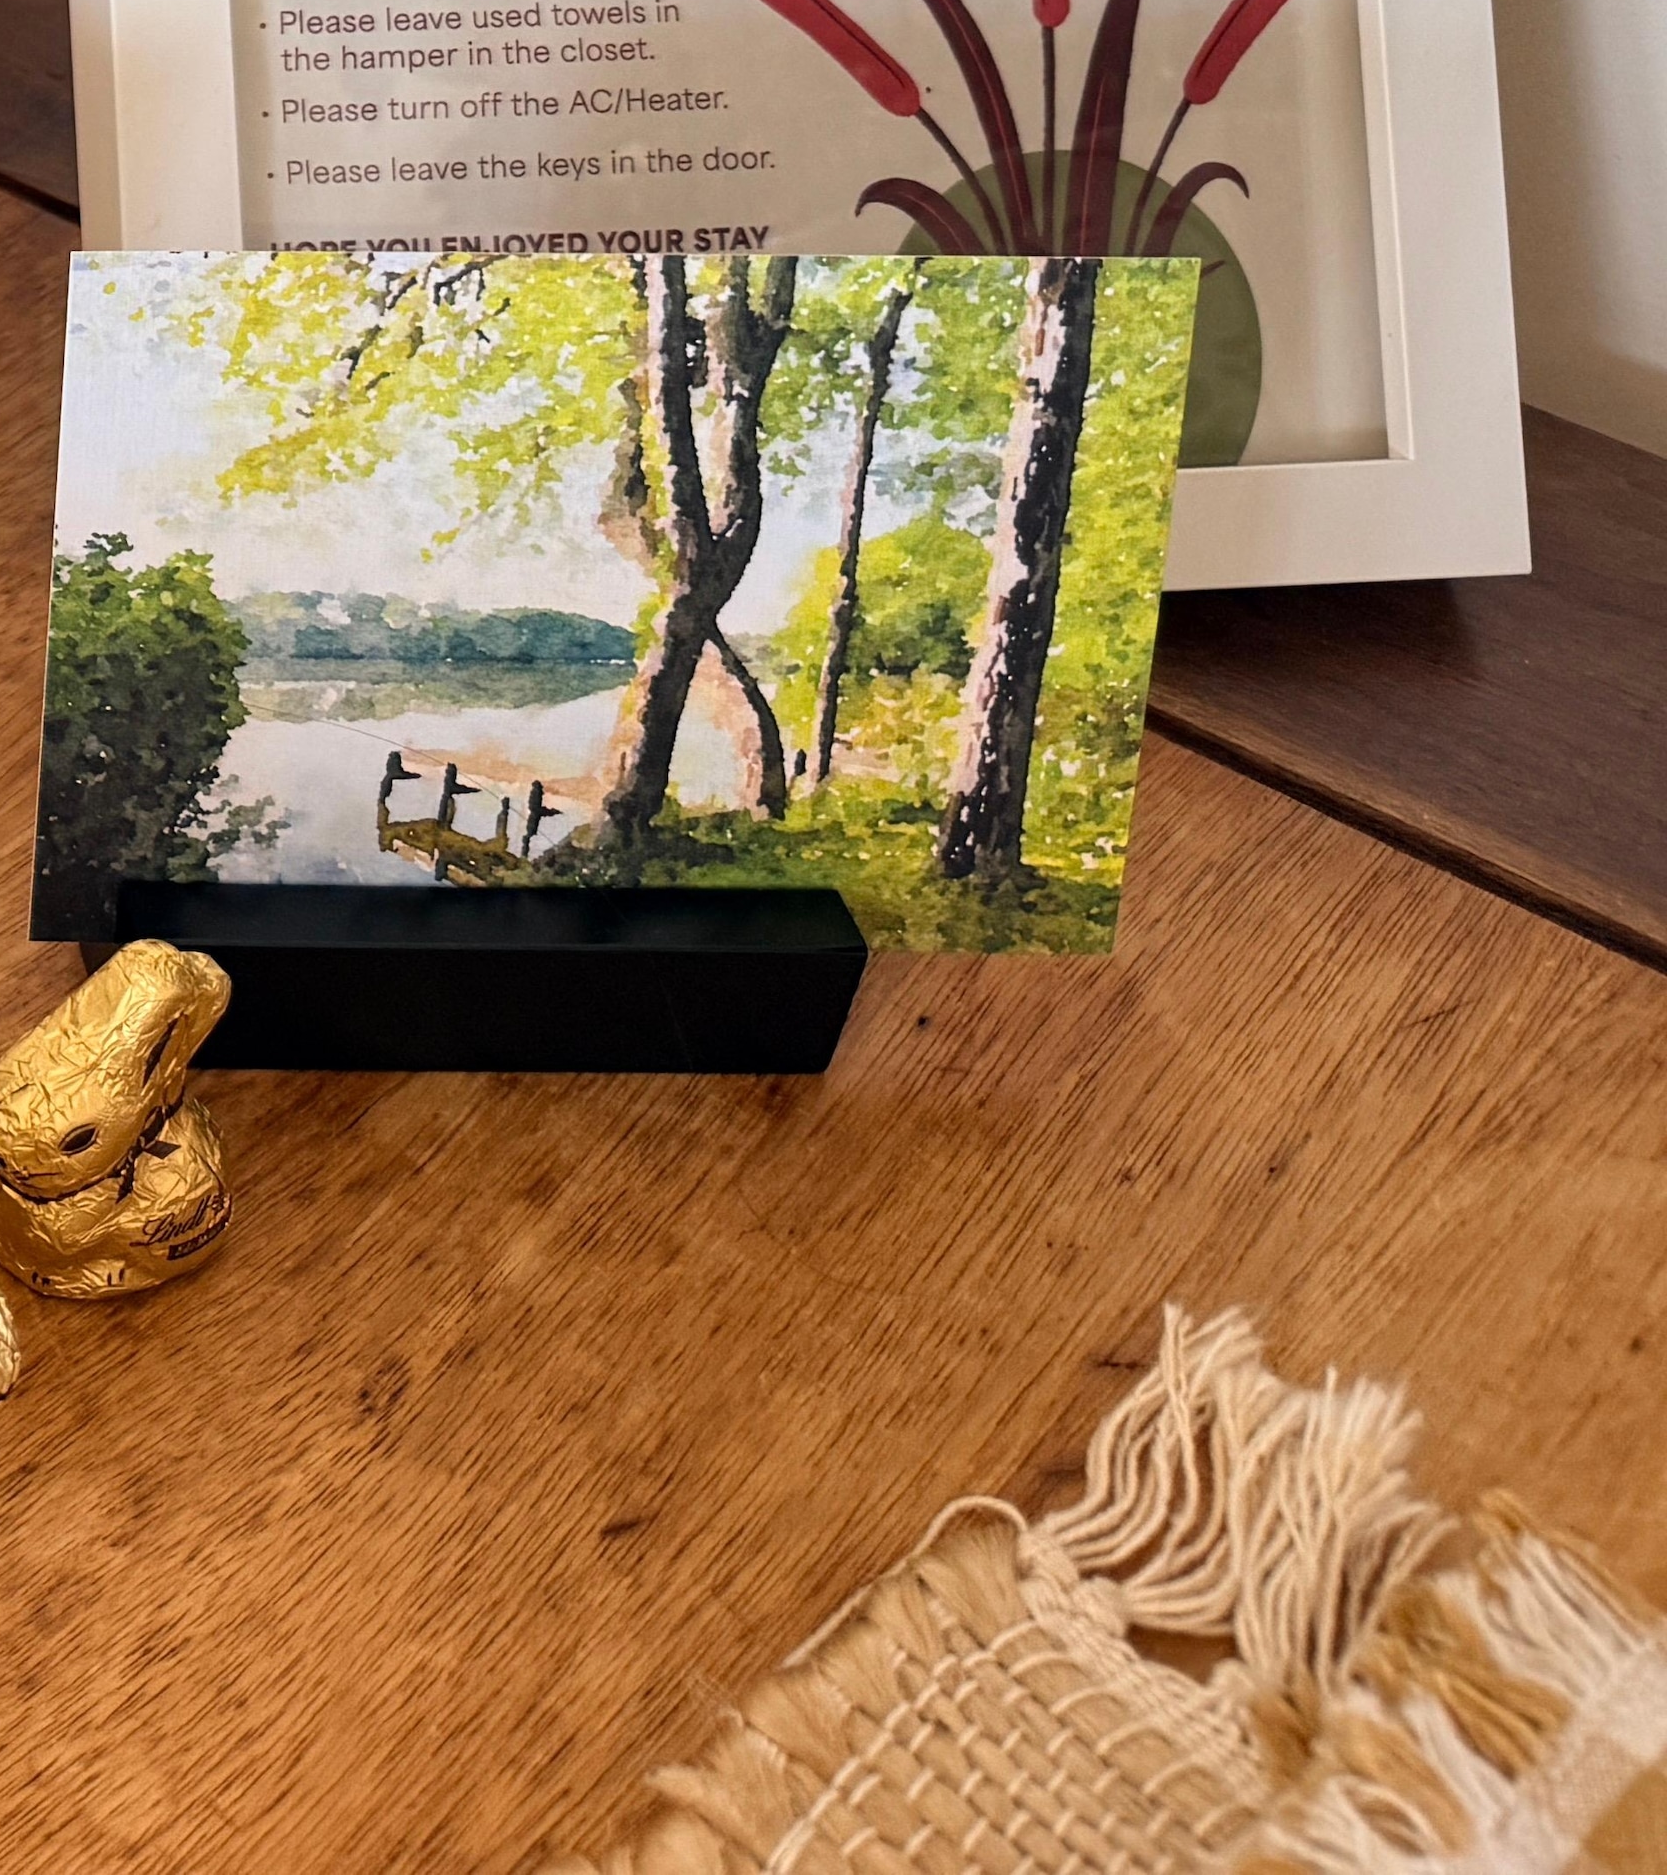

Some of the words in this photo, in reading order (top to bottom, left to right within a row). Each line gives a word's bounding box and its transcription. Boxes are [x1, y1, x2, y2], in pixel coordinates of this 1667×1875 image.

[282, 99, 378, 123] Please
[387, 98, 449, 120] turn
[461, 92, 502, 118] off
[511, 92, 559, 116] the
[570, 88, 728, 114] AC/Heater.
